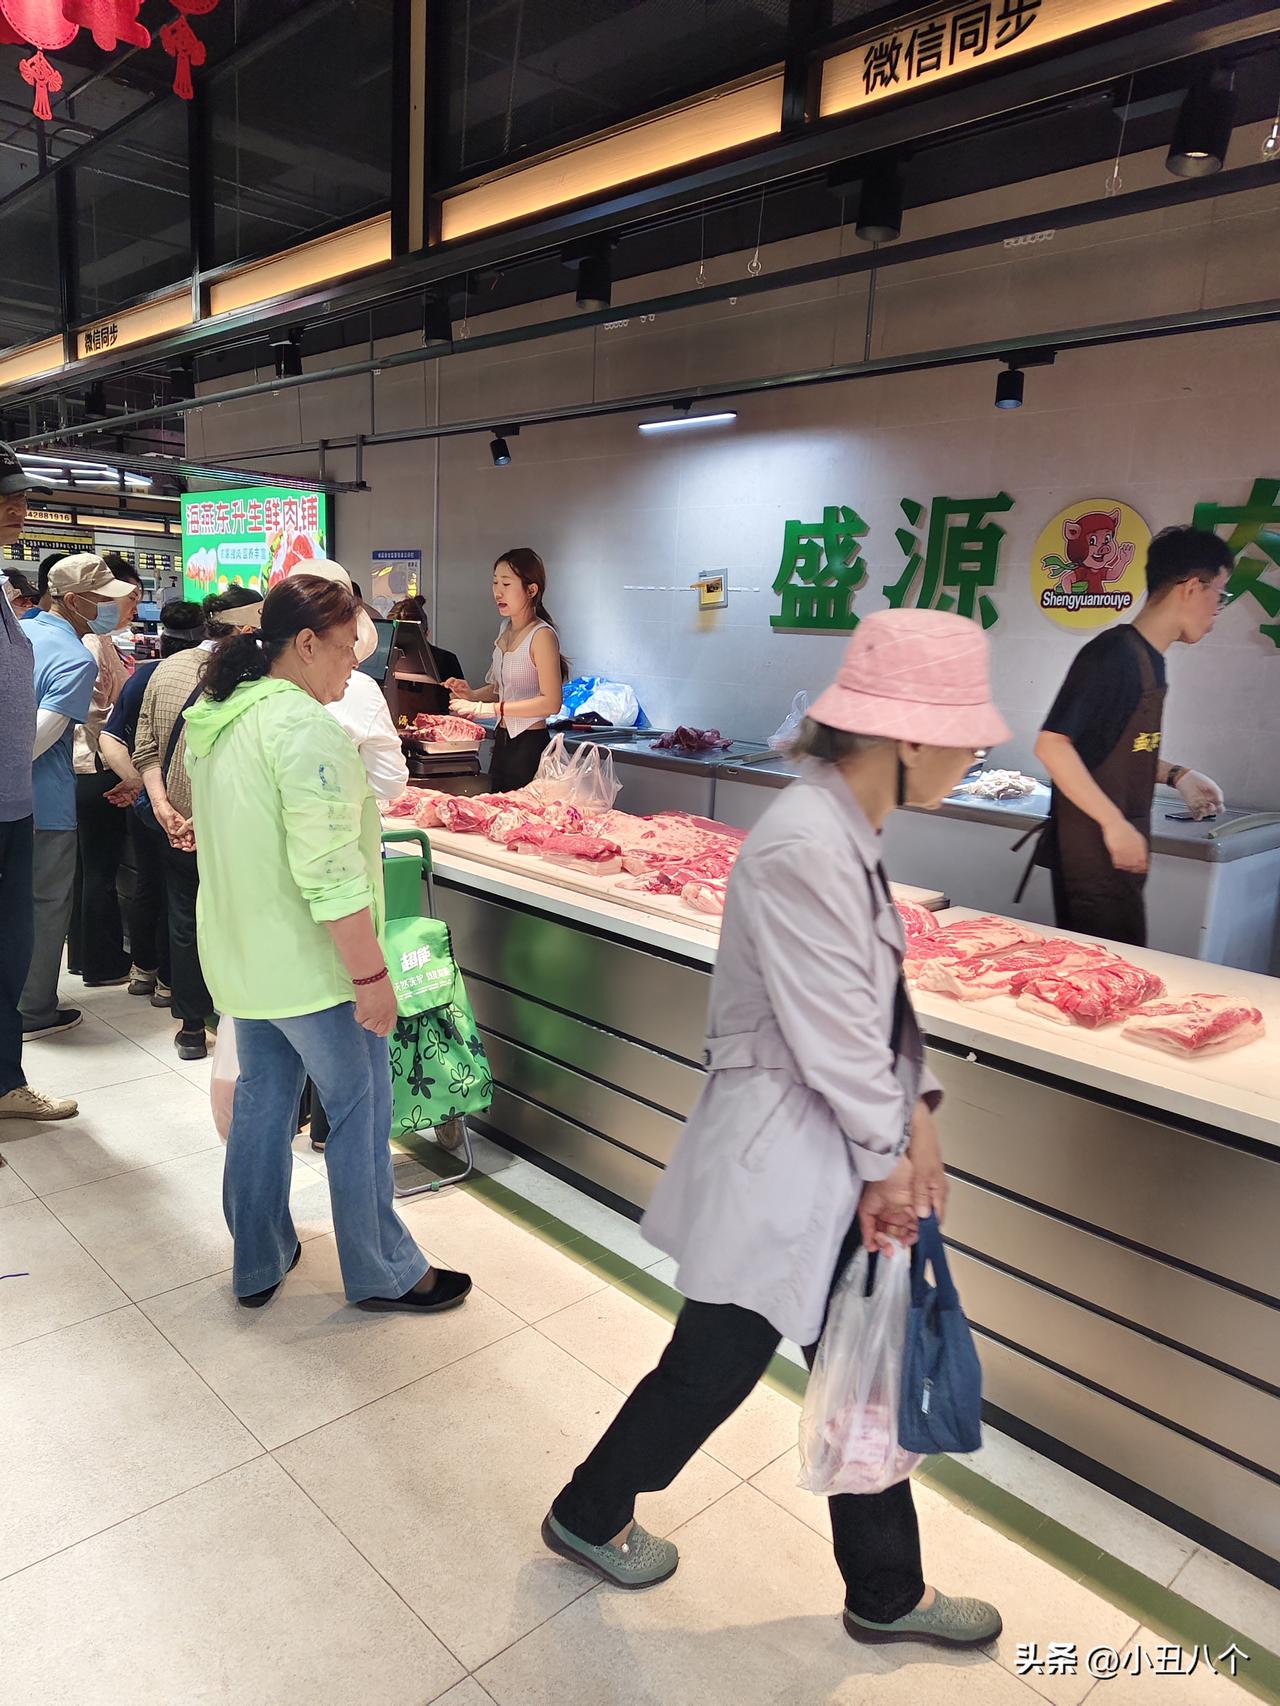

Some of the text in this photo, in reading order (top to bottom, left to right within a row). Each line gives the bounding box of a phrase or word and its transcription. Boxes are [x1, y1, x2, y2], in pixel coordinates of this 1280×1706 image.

[862, 0, 1043, 95] 微信同步
[84, 323, 119, 354] 微信同步
[26, 511, 70, 521] 42881916
[186, 494, 319, 536] 海燕东升生鲜肉铺
[1042, 591, 1131, 609] Shengyuanrouye
[401, 944, 432, 973] 超能
